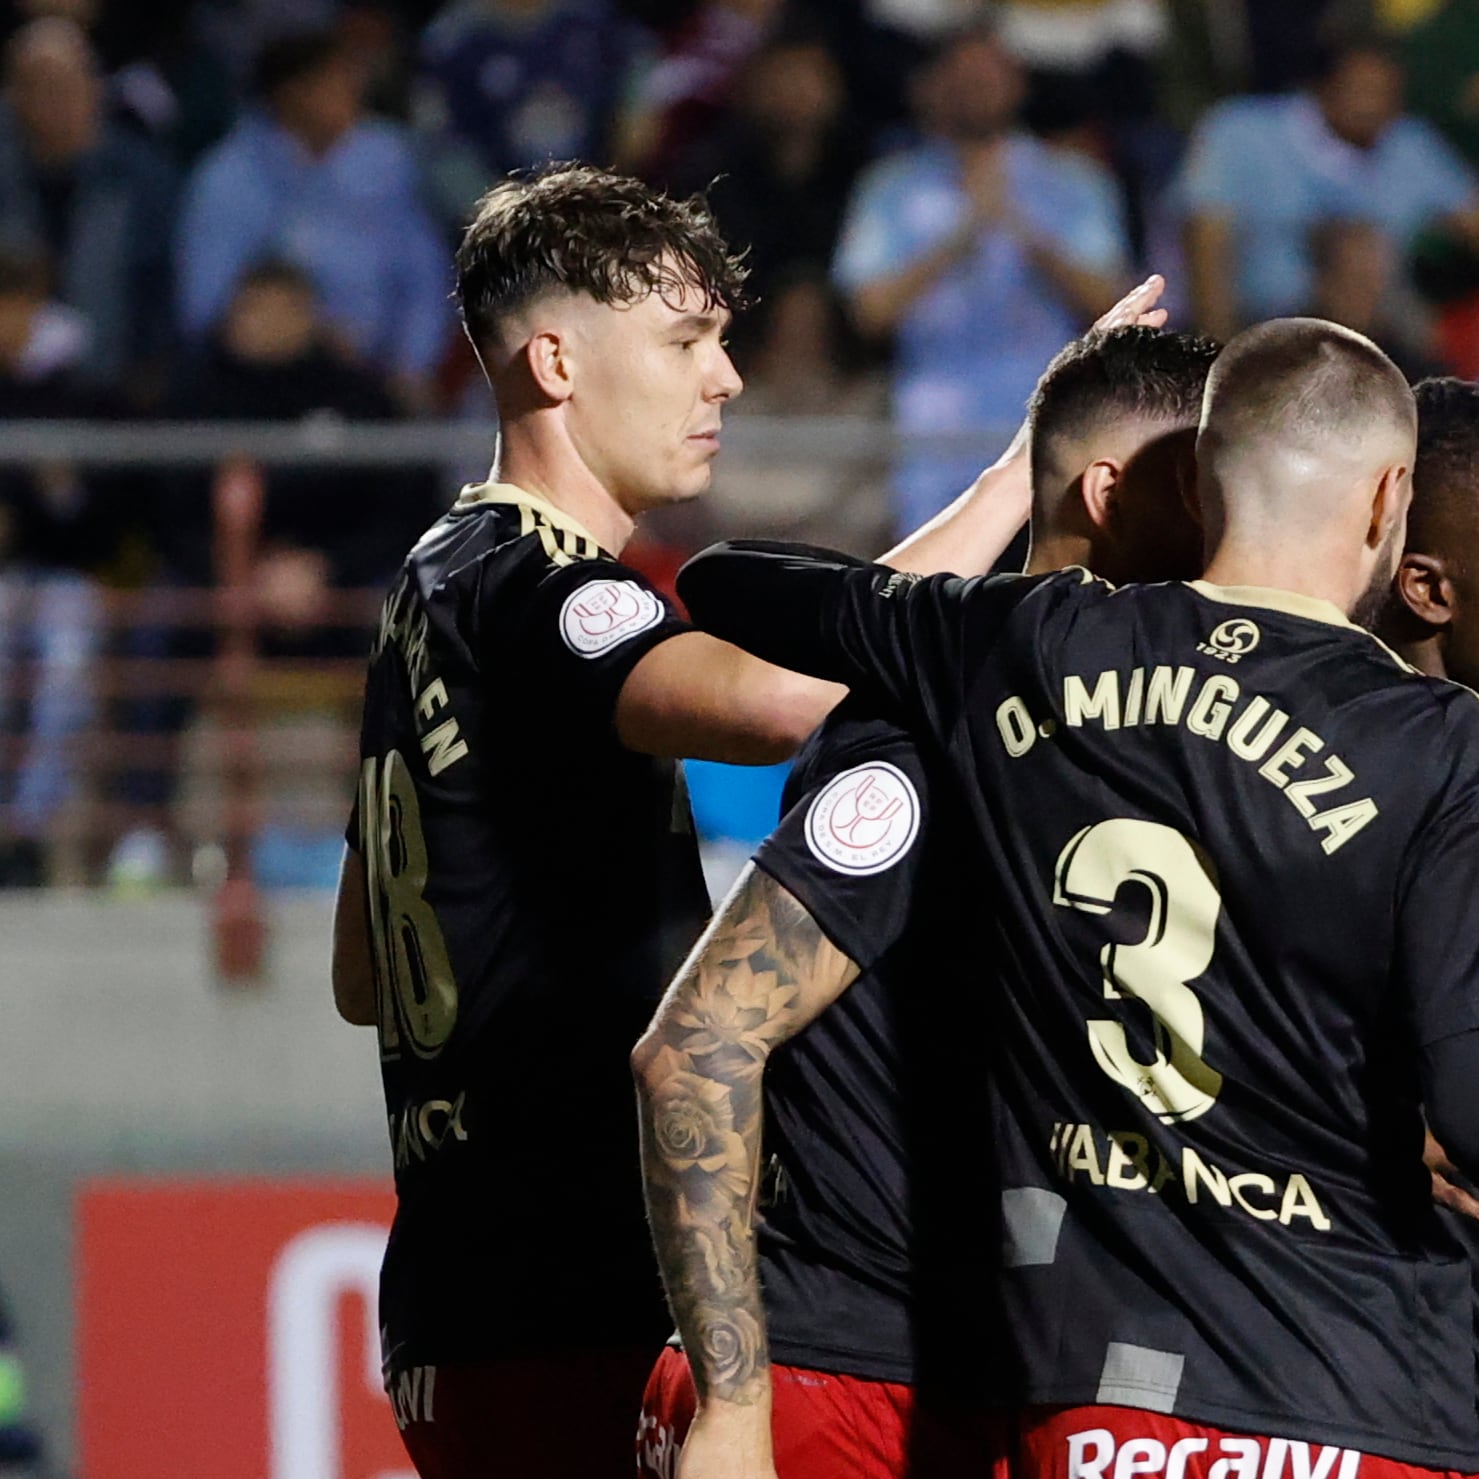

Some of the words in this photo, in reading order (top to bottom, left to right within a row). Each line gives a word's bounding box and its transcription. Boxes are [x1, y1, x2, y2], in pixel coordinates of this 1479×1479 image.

[1196, 641, 1241, 665] 1923
[995, 695, 1056, 758] O.
[1064, 665, 1379, 856] MINGUEZA
[1053, 817, 1223, 1126] 3
